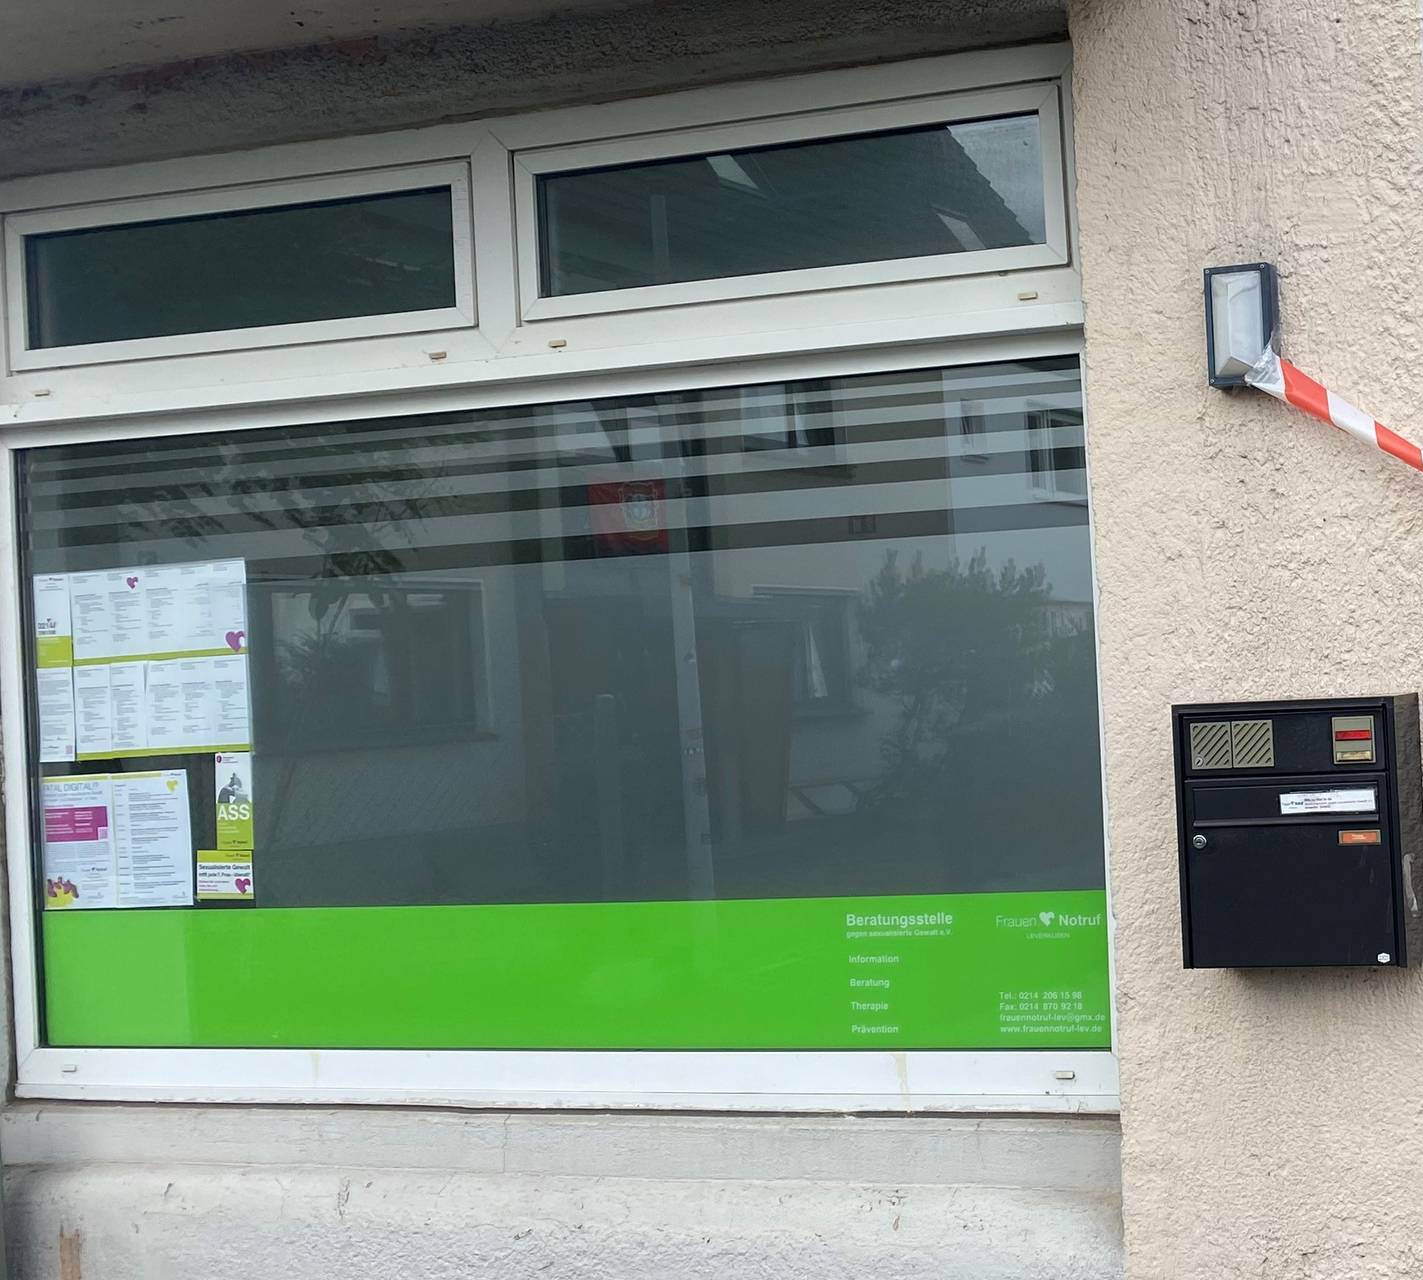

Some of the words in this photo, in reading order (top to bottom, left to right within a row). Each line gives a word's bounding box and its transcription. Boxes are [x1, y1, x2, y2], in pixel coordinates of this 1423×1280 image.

[218, 804, 250, 820] ASS
[846, 911, 953, 928] Beratungsstelle
[995, 915, 1037, 928] Frauen
[1058, 913, 1102, 926] Notruf
[848, 955, 900, 964] Information
[849, 978, 890, 989] Beratung
[1019, 991, 1039, 1000] 0214
[1060, 991, 1070, 1000] 15
[851, 1001, 889, 1012] Therapie
[1019, 1002, 1039, 1011] 0214
[1000, 1013, 1105, 1023] frauennotruf-lev@gmx.de
[851, 1024, 899, 1034] Prävention
[1000, 1024, 1103, 1033] www.frauennotruf-lev.de
